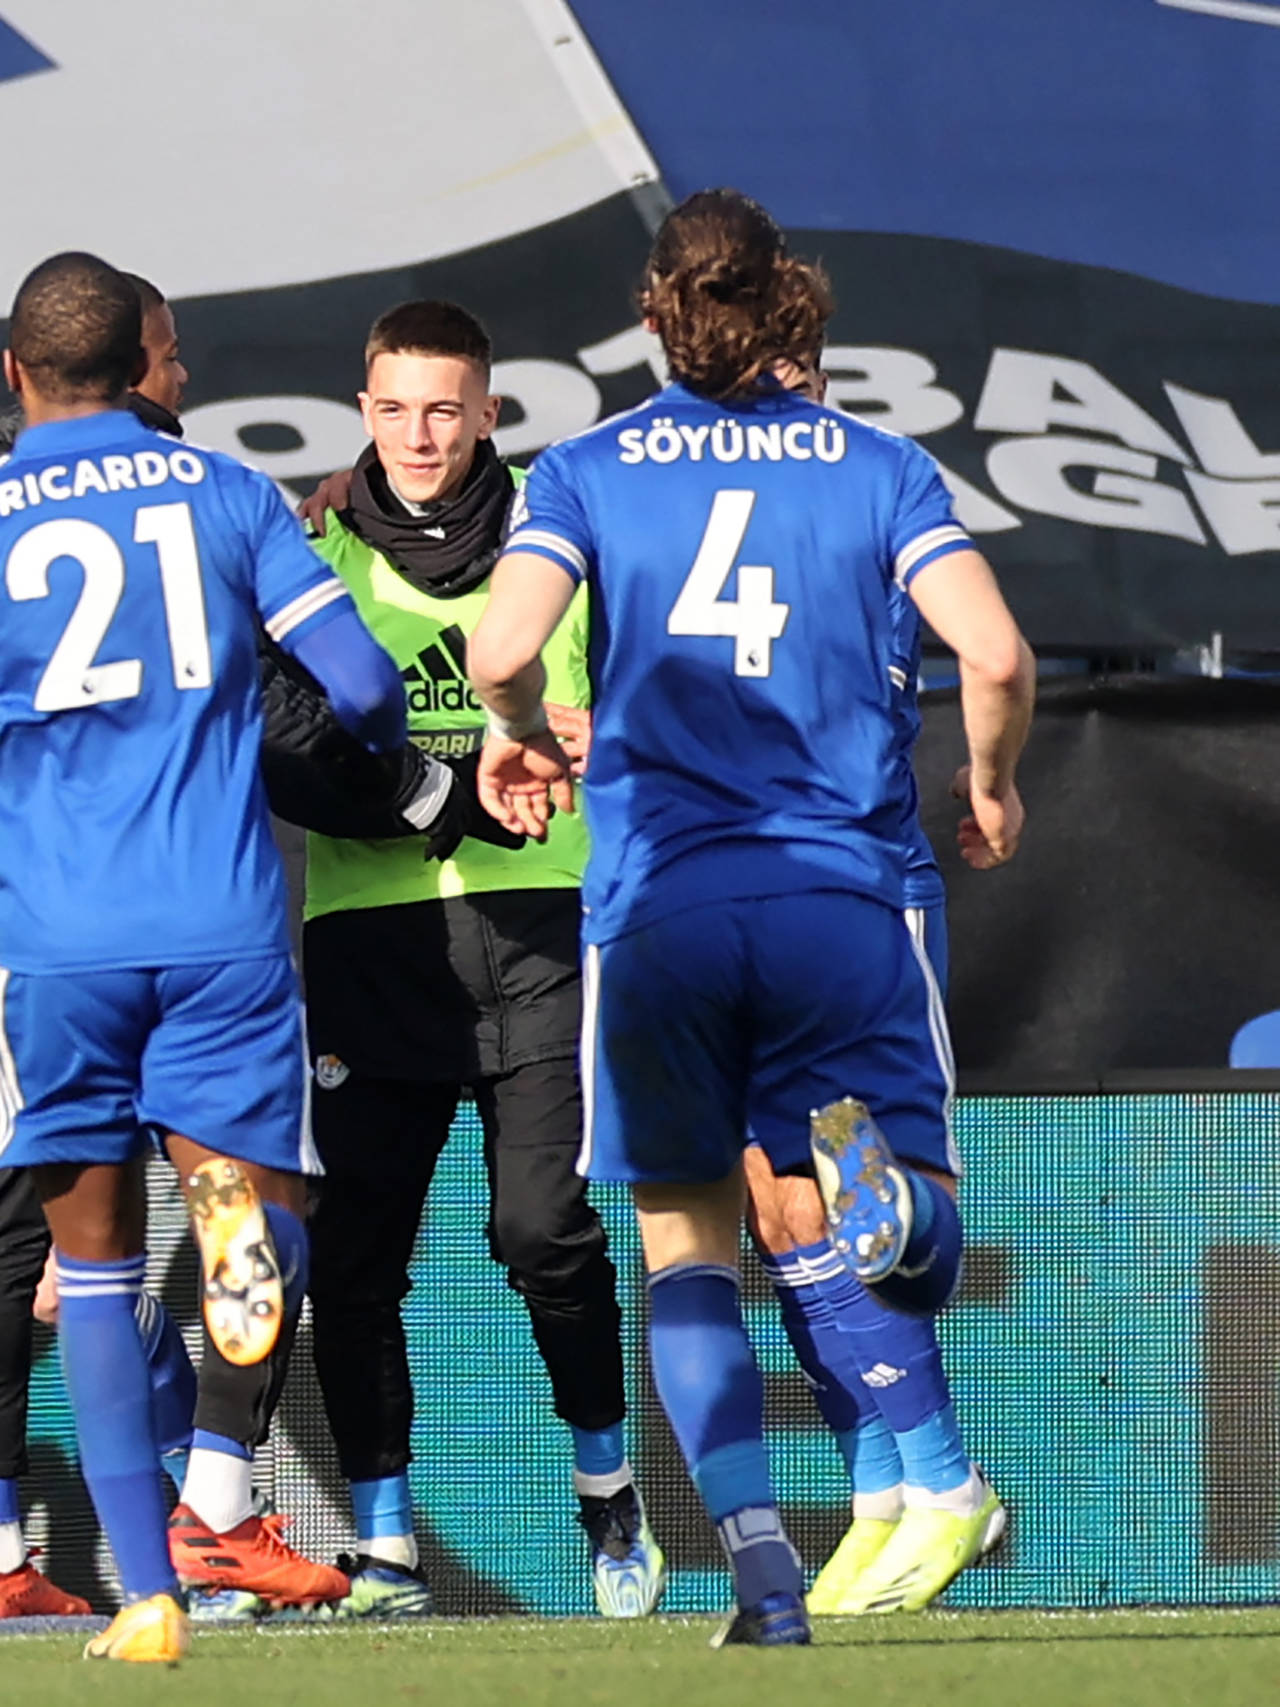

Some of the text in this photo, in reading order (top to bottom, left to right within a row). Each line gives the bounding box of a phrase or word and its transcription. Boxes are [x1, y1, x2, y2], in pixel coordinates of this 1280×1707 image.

[618, 417, 846, 464] SÖYÜNCÜ
[5, 502, 212, 711] 21
[667, 488, 790, 678] 4
